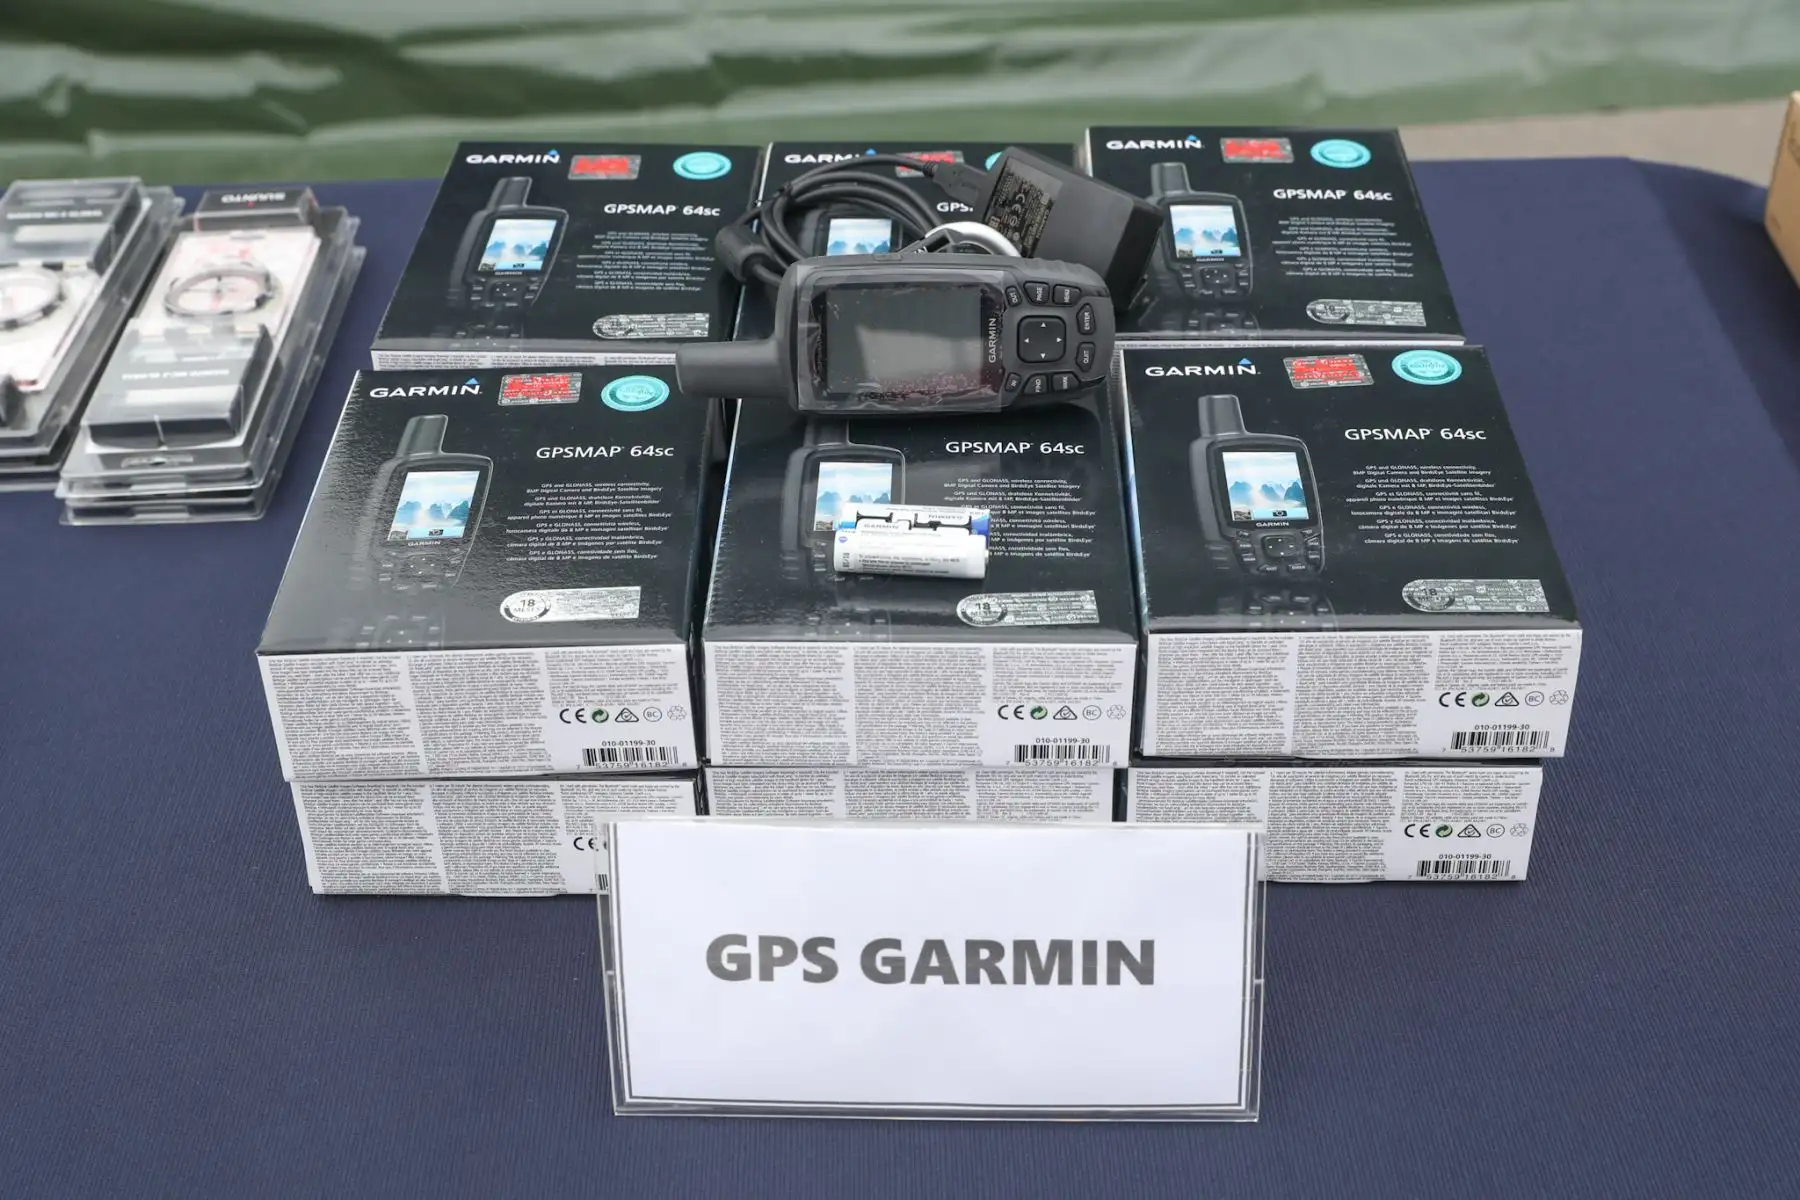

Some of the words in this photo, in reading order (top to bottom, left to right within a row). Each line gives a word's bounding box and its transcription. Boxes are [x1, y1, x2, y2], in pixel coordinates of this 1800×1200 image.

[1106, 140, 1200, 150] GARMIN
[466, 154, 560, 164] GARMIN
[784, 154, 859, 163] GARM
[1273, 189, 1346, 200] GPSMAP
[1352, 190, 1393, 201] 64sc
[604, 204, 676, 216] GPSMAP
[682, 205, 720, 216] 64sc
[1010, 292, 1018, 304] OUT
[988, 317, 997, 363] GARMIN
[1145, 365, 1258, 376] GARMIN
[370, 384, 480, 398] GARMIN
[1344, 428, 1430, 441] GPSMAP
[1440, 428, 1487, 440] 64sc
[536, 446, 622, 459] GPSMAP
[630, 445, 674, 457] 64sc
[946, 442, 1030, 454] GPSMAP
[1040, 442, 1085, 454] 64sc
[520, 599, 535, 607] 18
[706, 933, 838, 983] GPS
[860, 938, 1155, 986] GARMIN
